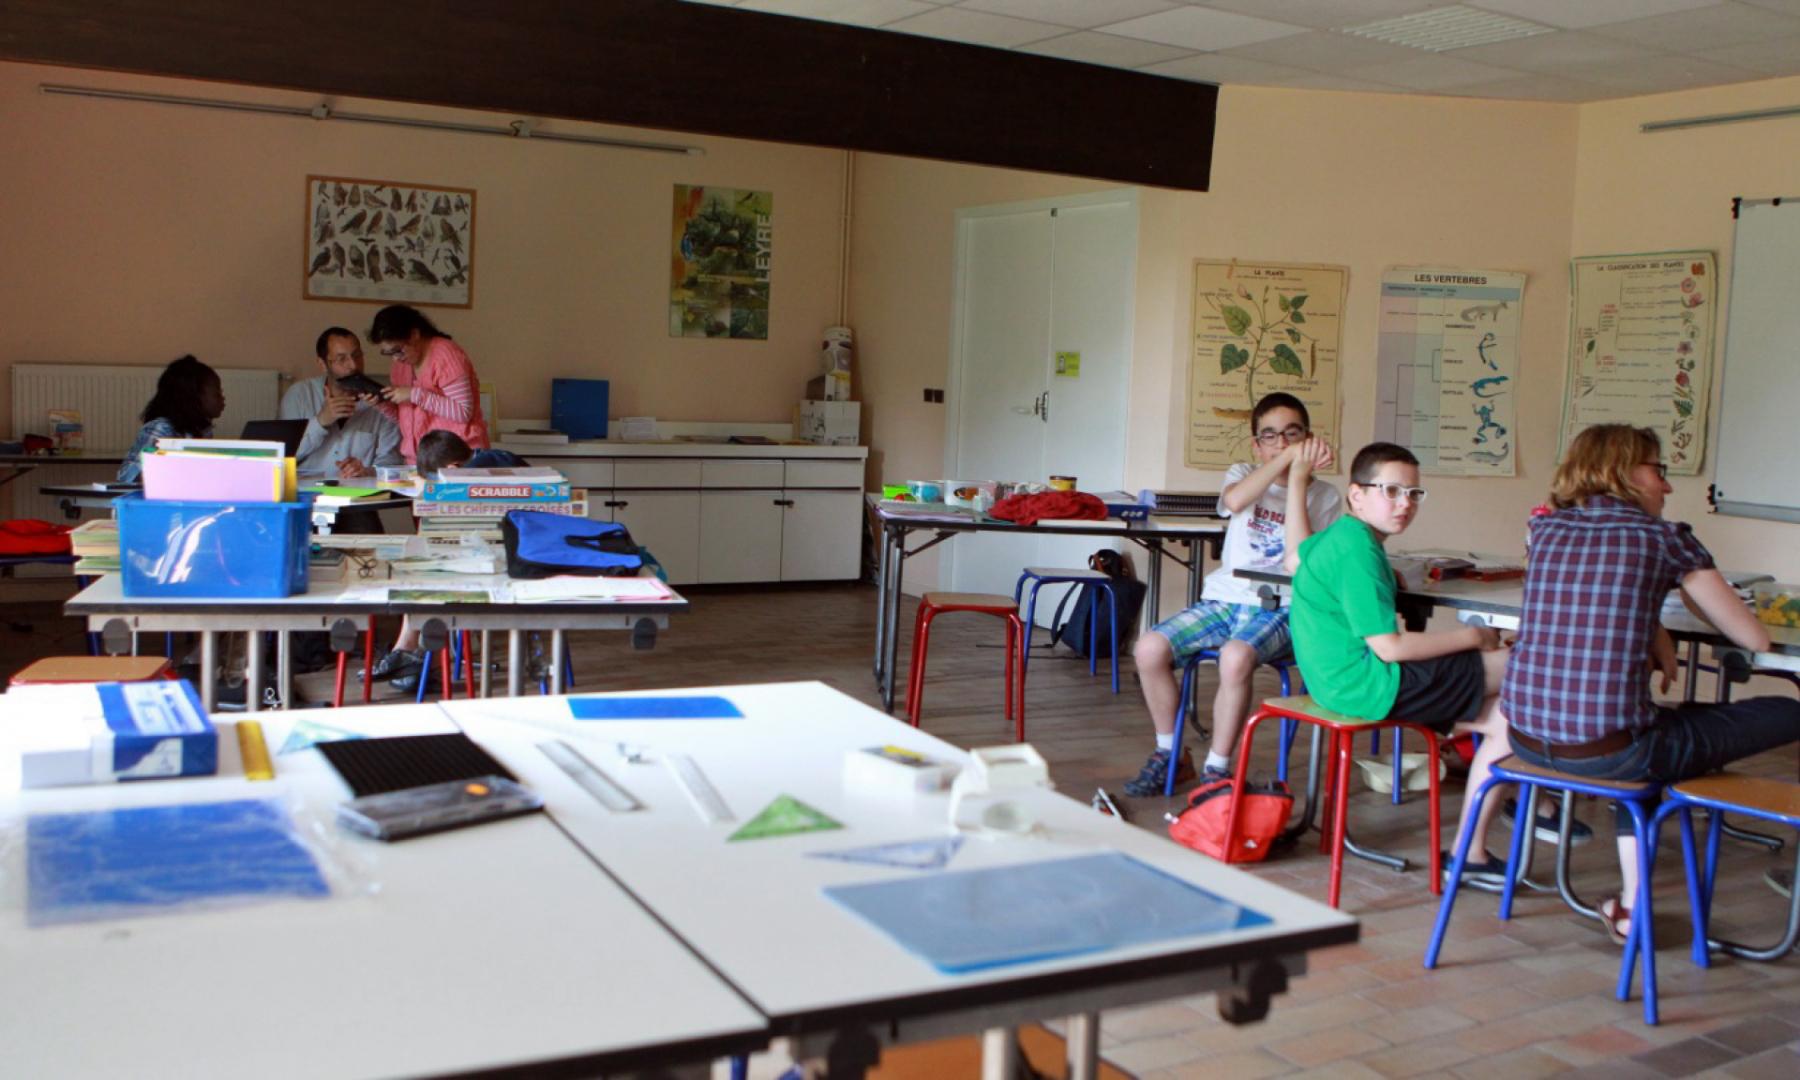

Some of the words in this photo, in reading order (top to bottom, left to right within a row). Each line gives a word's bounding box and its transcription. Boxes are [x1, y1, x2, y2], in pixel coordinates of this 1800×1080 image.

[755, 213, 772, 283] LEYRE
[1414, 274, 1431, 282] LES
[1433, 274, 1487, 285] VERTEBRES
[470, 486, 530, 497] SCRABBLE
[440, 503, 461, 514] LES
